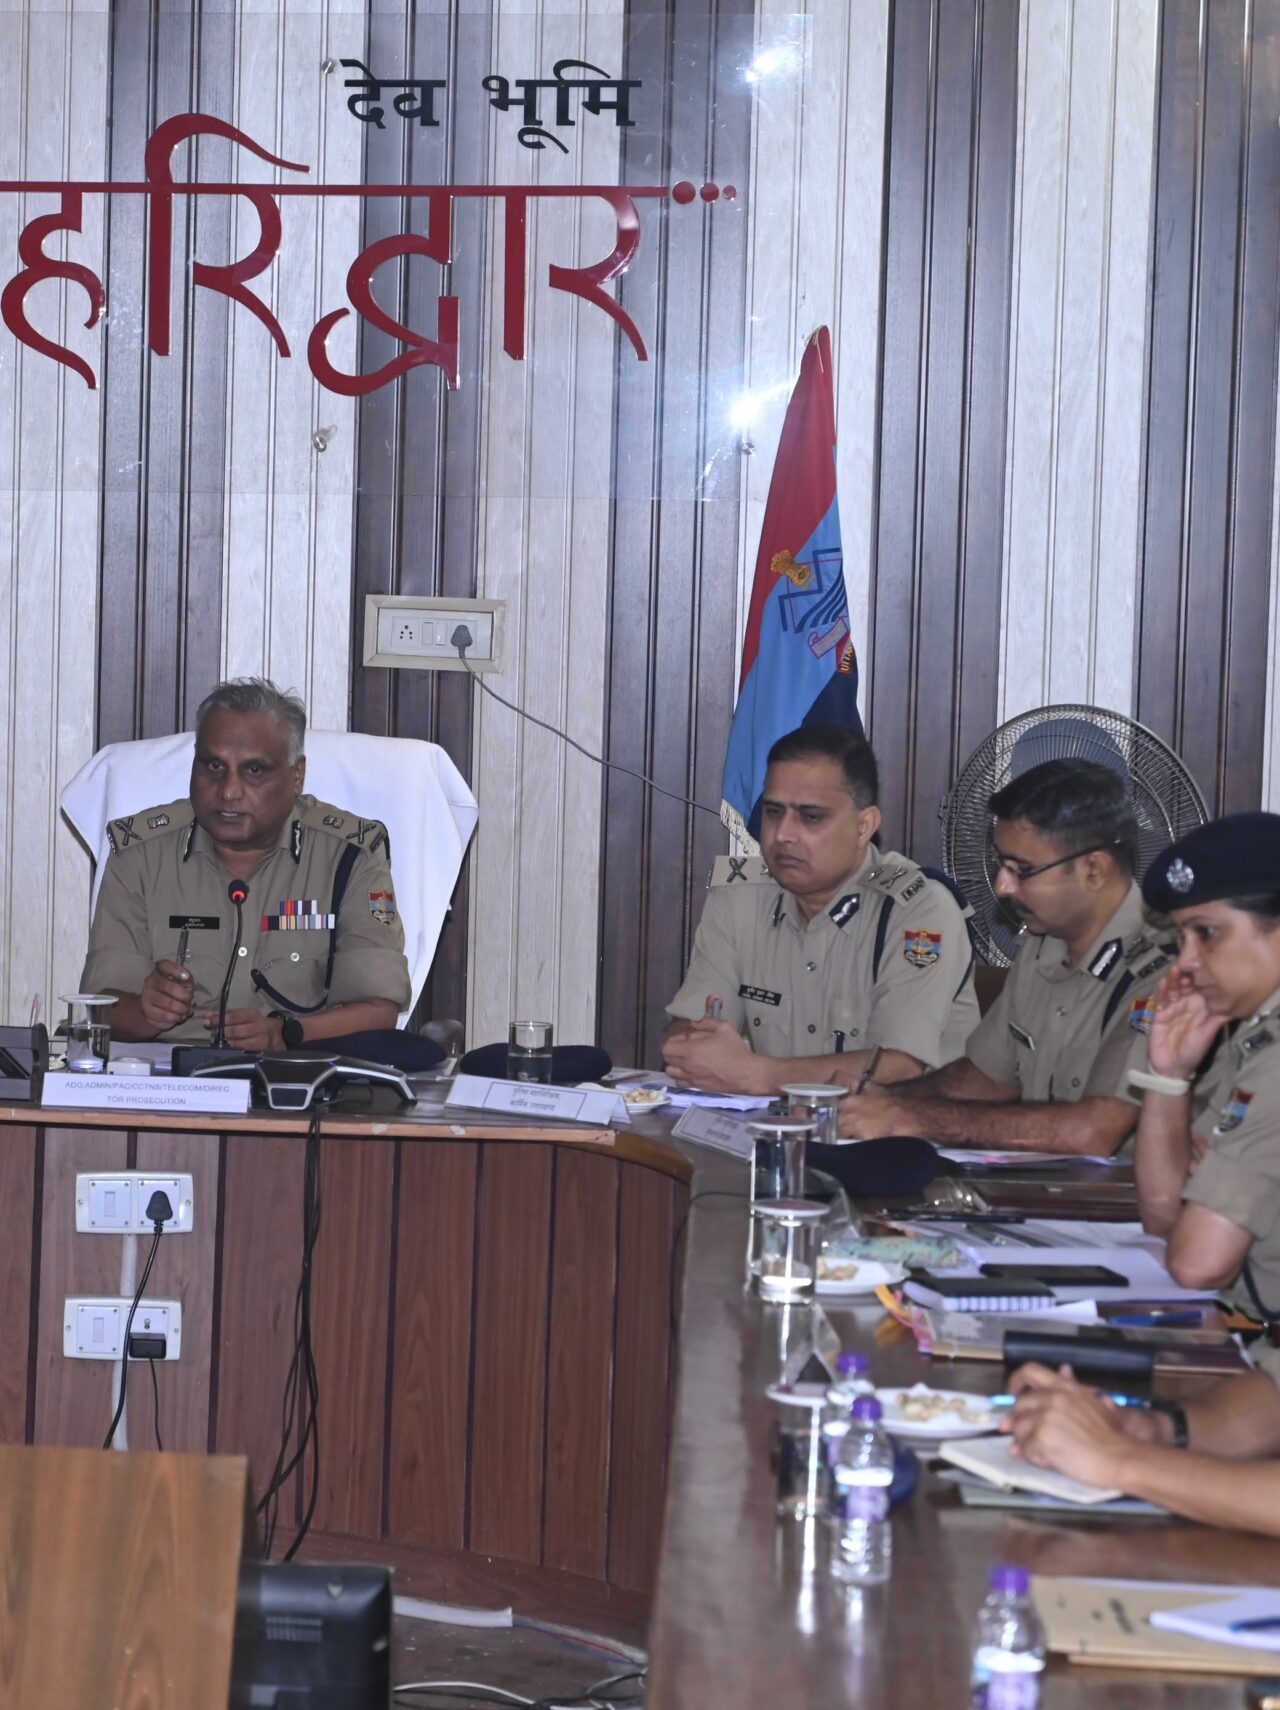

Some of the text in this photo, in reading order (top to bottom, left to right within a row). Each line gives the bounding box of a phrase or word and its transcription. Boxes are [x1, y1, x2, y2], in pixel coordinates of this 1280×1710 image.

[340, 59, 642, 154] देव भूमि
[106, 1096, 186, 1105] TOR PROSECUTION
